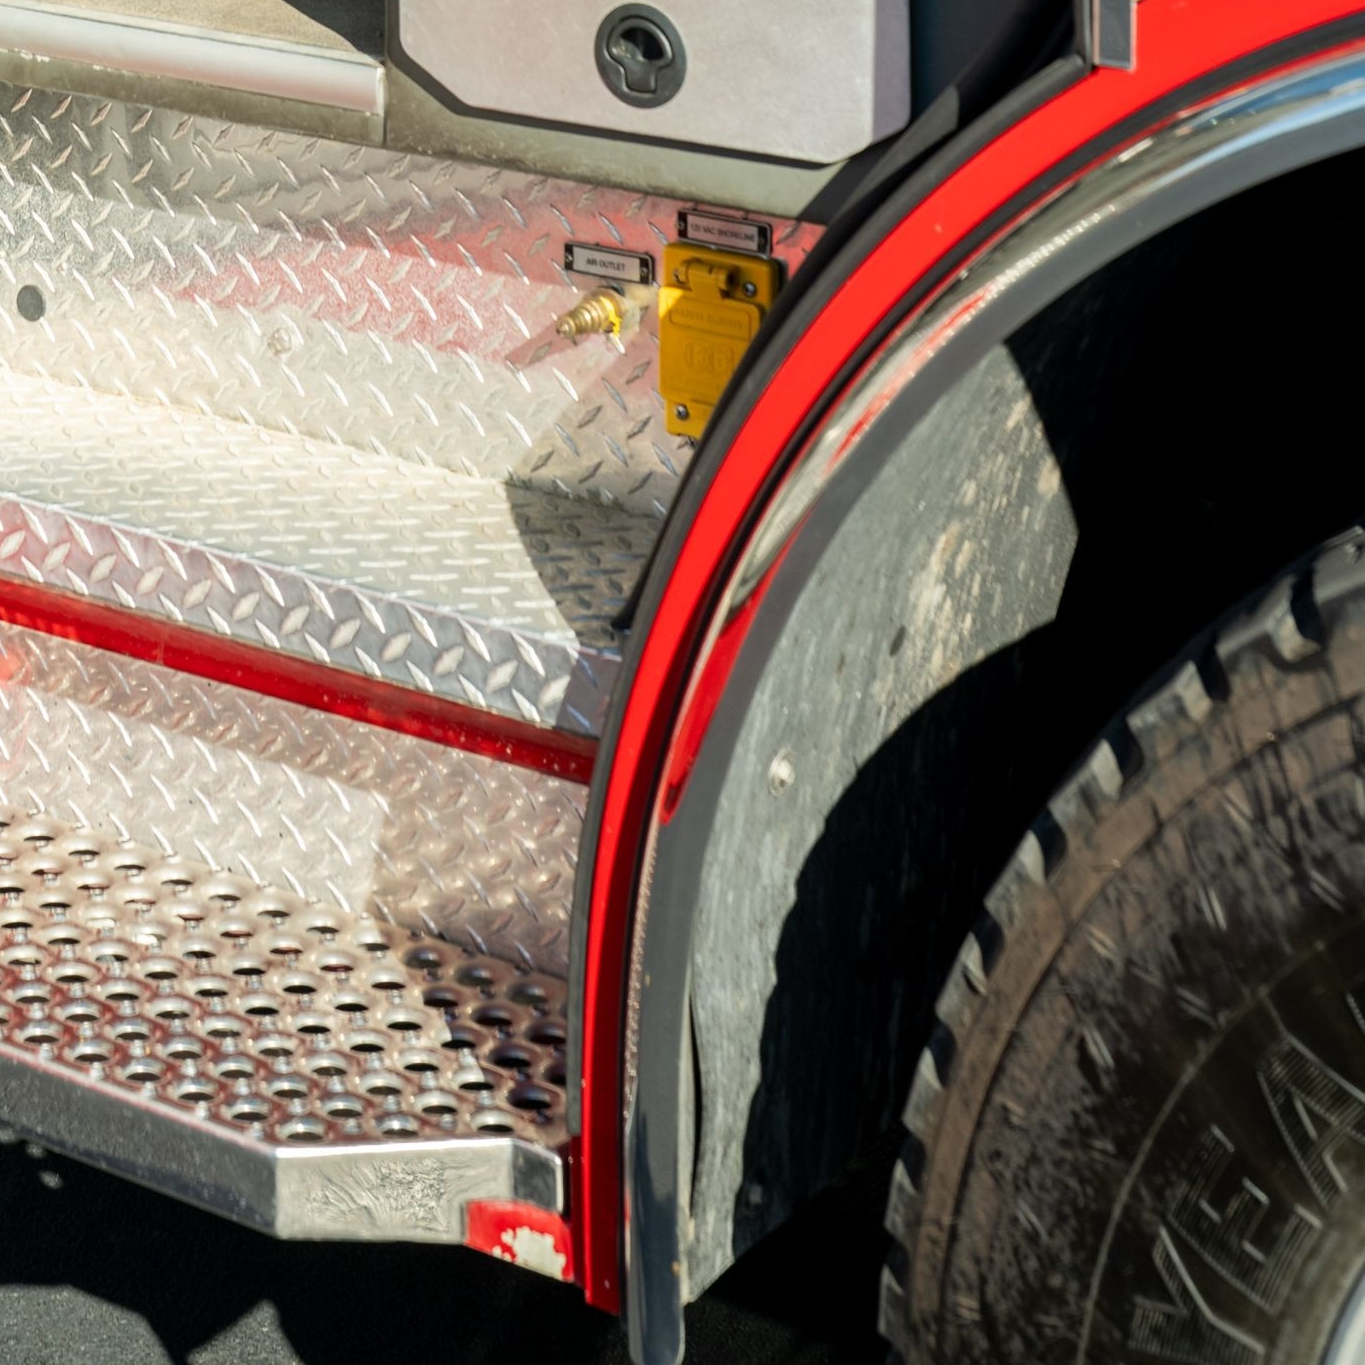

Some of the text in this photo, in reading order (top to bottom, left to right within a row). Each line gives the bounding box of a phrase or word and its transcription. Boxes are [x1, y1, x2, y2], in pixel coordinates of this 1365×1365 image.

[587, 257, 625, 273] AIR OUTLET
[1127, 991, 1365, 1365] YEA
